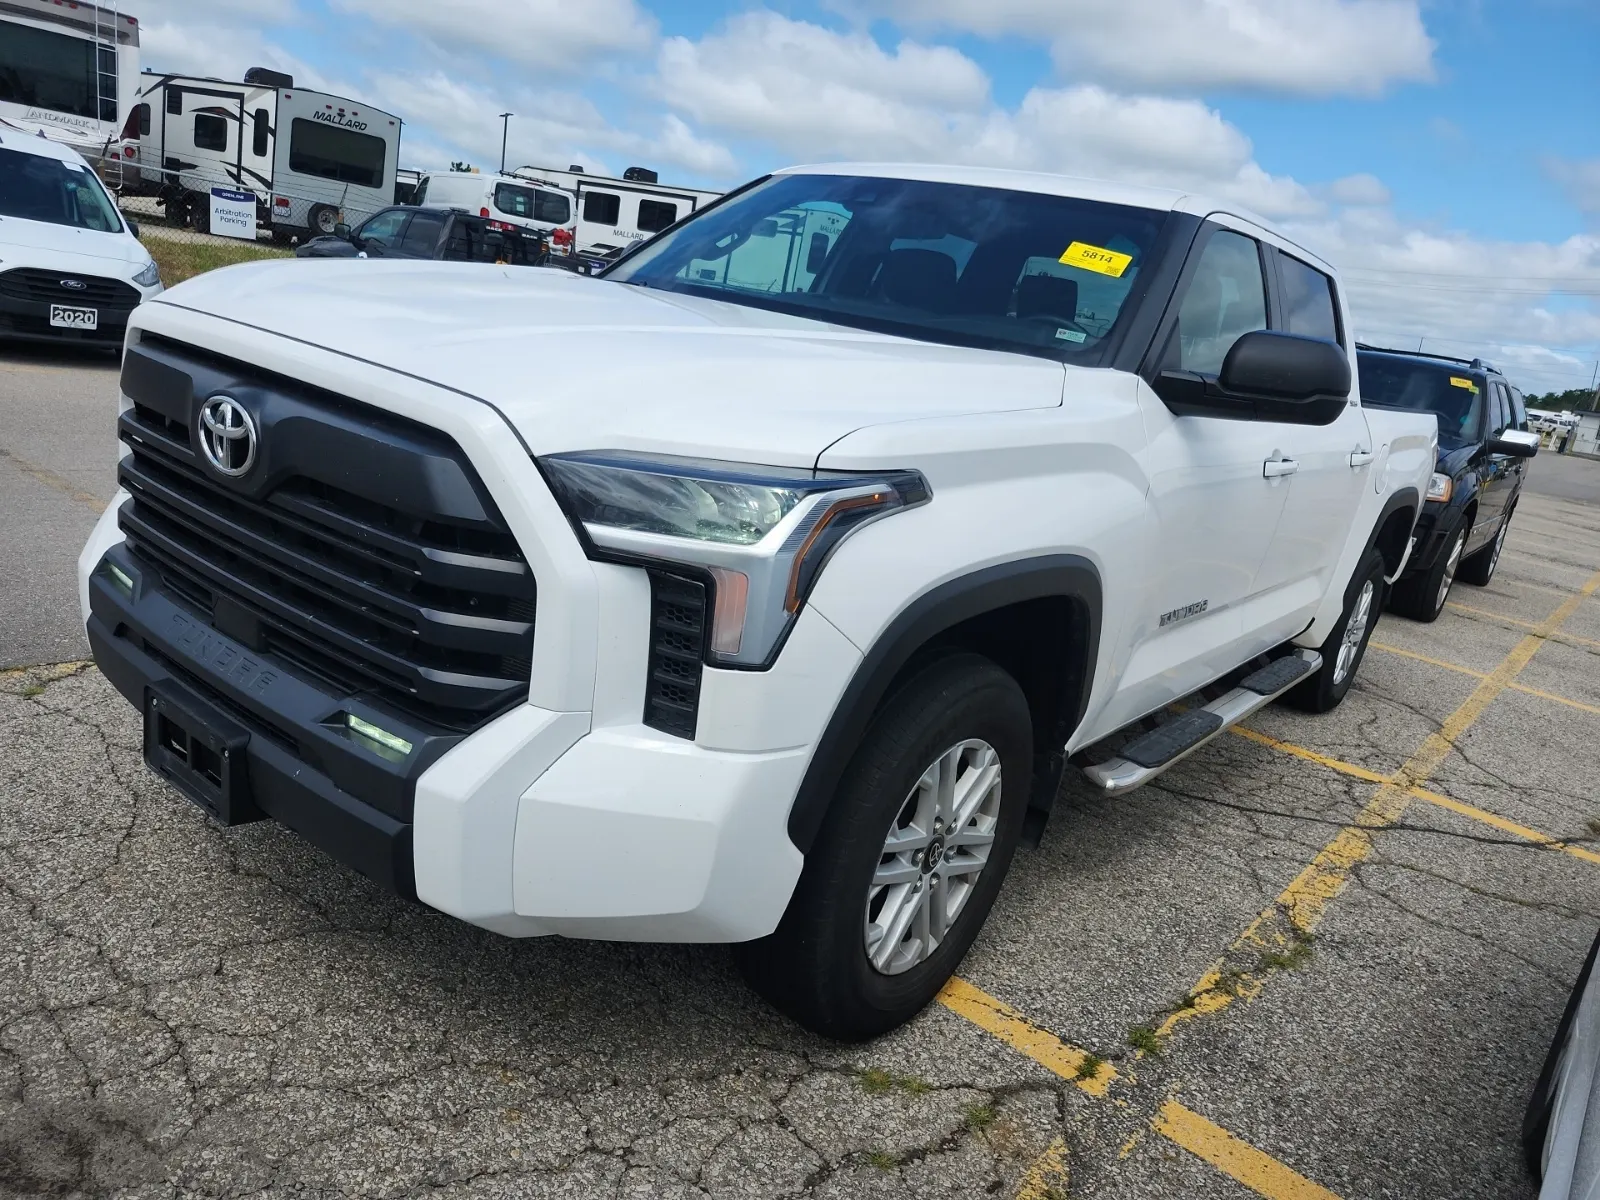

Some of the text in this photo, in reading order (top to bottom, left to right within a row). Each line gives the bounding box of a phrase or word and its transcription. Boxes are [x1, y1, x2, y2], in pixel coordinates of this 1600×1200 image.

[21, 106, 91, 129] LANDMARK
[313, 110, 368, 131] MALLARD
[214, 207, 253, 219] Arbitration
[220, 216, 247, 227] Parking
[612, 229, 644, 240] MALLARD
[1081, 250, 1114, 263] 5814
[53, 310, 95, 324] 2020
[1159, 599, 1209, 628] TUNDRA
[164, 613, 279, 696] TUNDRA
